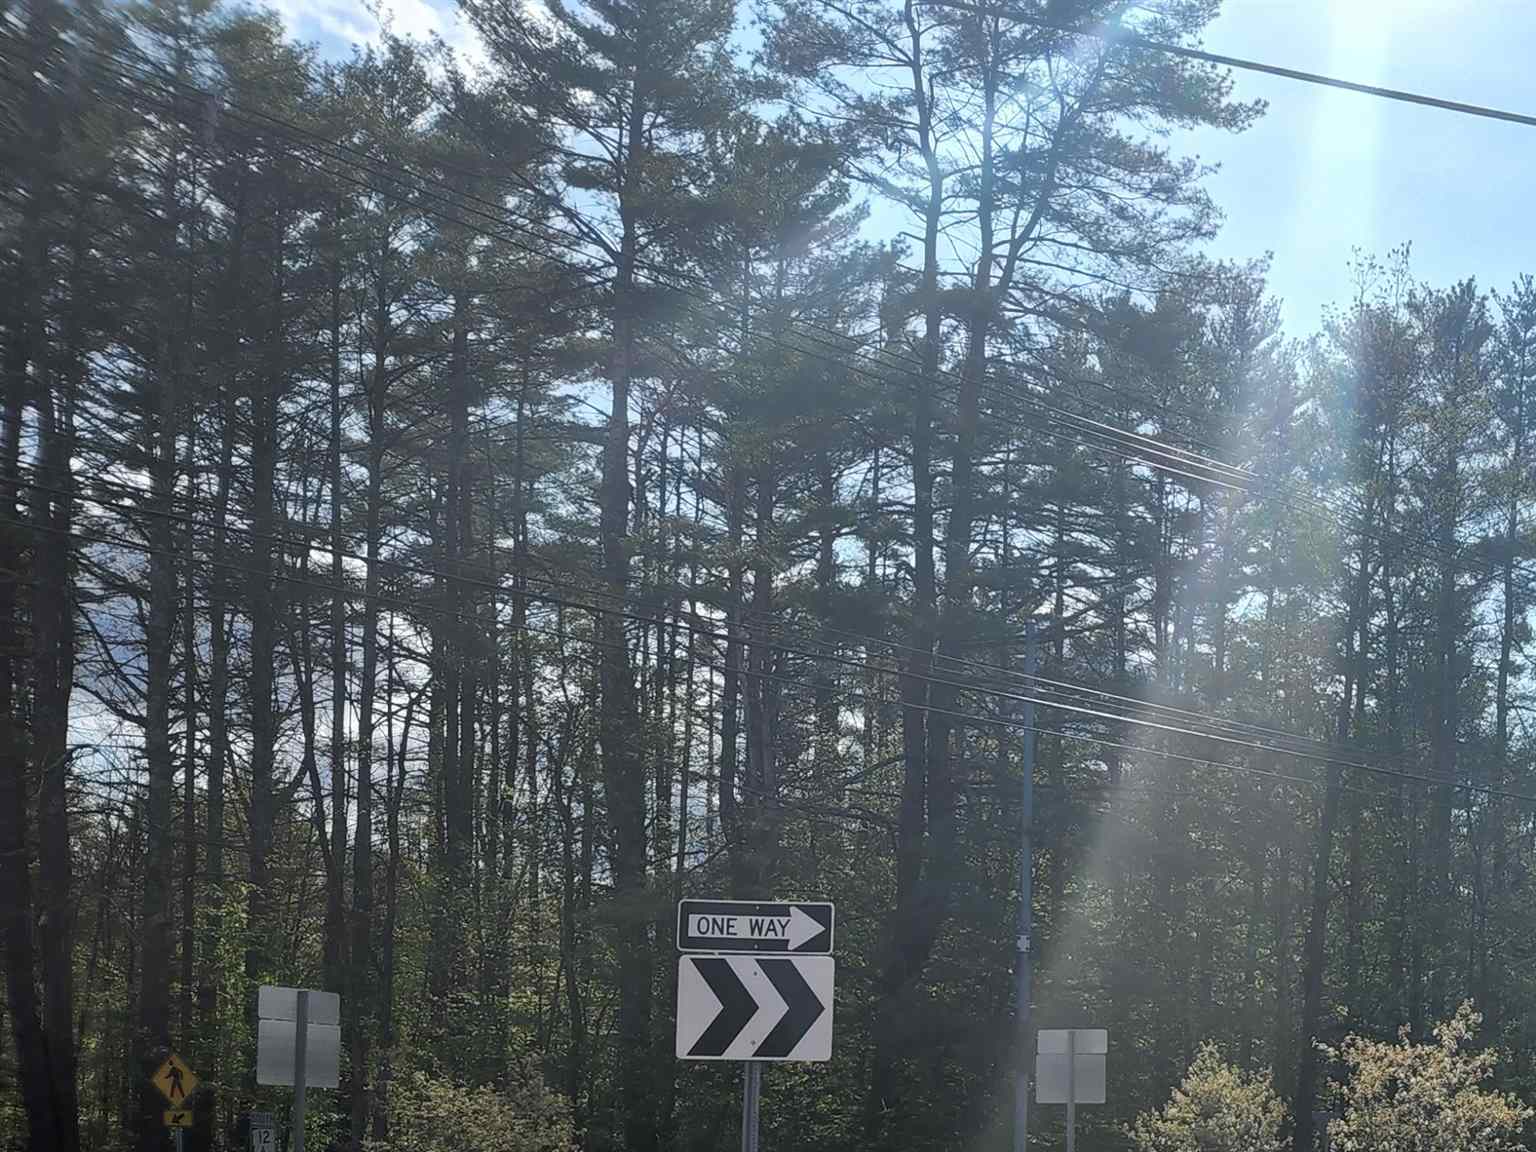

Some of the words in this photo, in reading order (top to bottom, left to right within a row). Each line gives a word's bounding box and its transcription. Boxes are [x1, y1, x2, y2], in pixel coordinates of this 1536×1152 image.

[696, 916, 738, 936] ONE
[749, 918, 791, 937] WAY
[258, 1130, 271, 1144] 12
